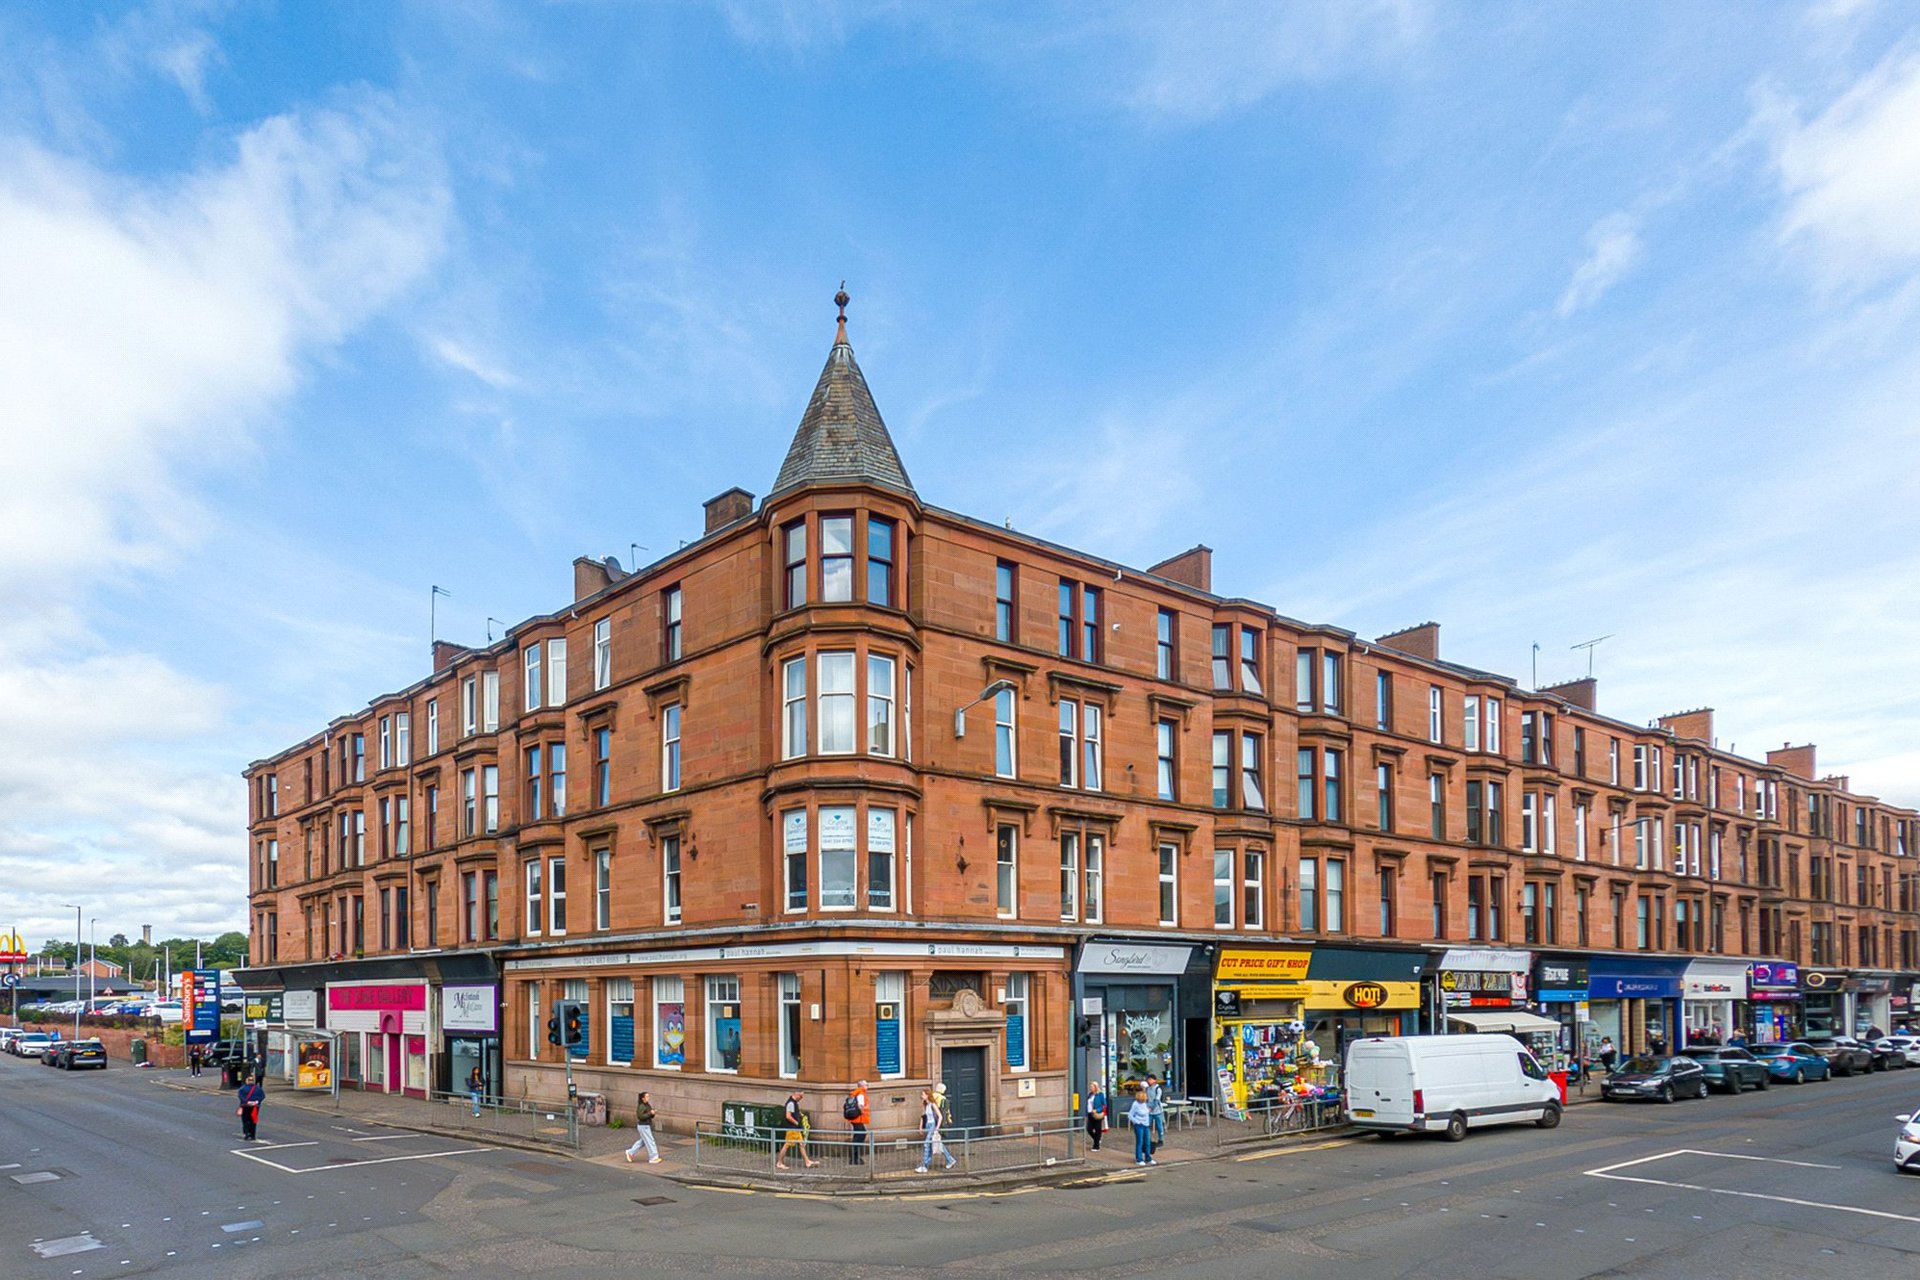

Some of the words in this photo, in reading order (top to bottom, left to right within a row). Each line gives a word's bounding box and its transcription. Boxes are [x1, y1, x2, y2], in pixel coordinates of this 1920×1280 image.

[741, 948, 765, 957] hannah
[956, 946, 983, 955] hannah
[1221, 958, 1239, 968] CUT
[1239, 958, 1265, 968] PRICE
[1267, 959, 1286, 968] GIFT
[1287, 959, 1309, 969] SHOP
[183, 977, 191, 1025] Sainsbury's
[338, 989, 351, 1004] THE
[377, 986, 414, 1004] GALLERY
[1354, 987, 1381, 1002] HOT!
